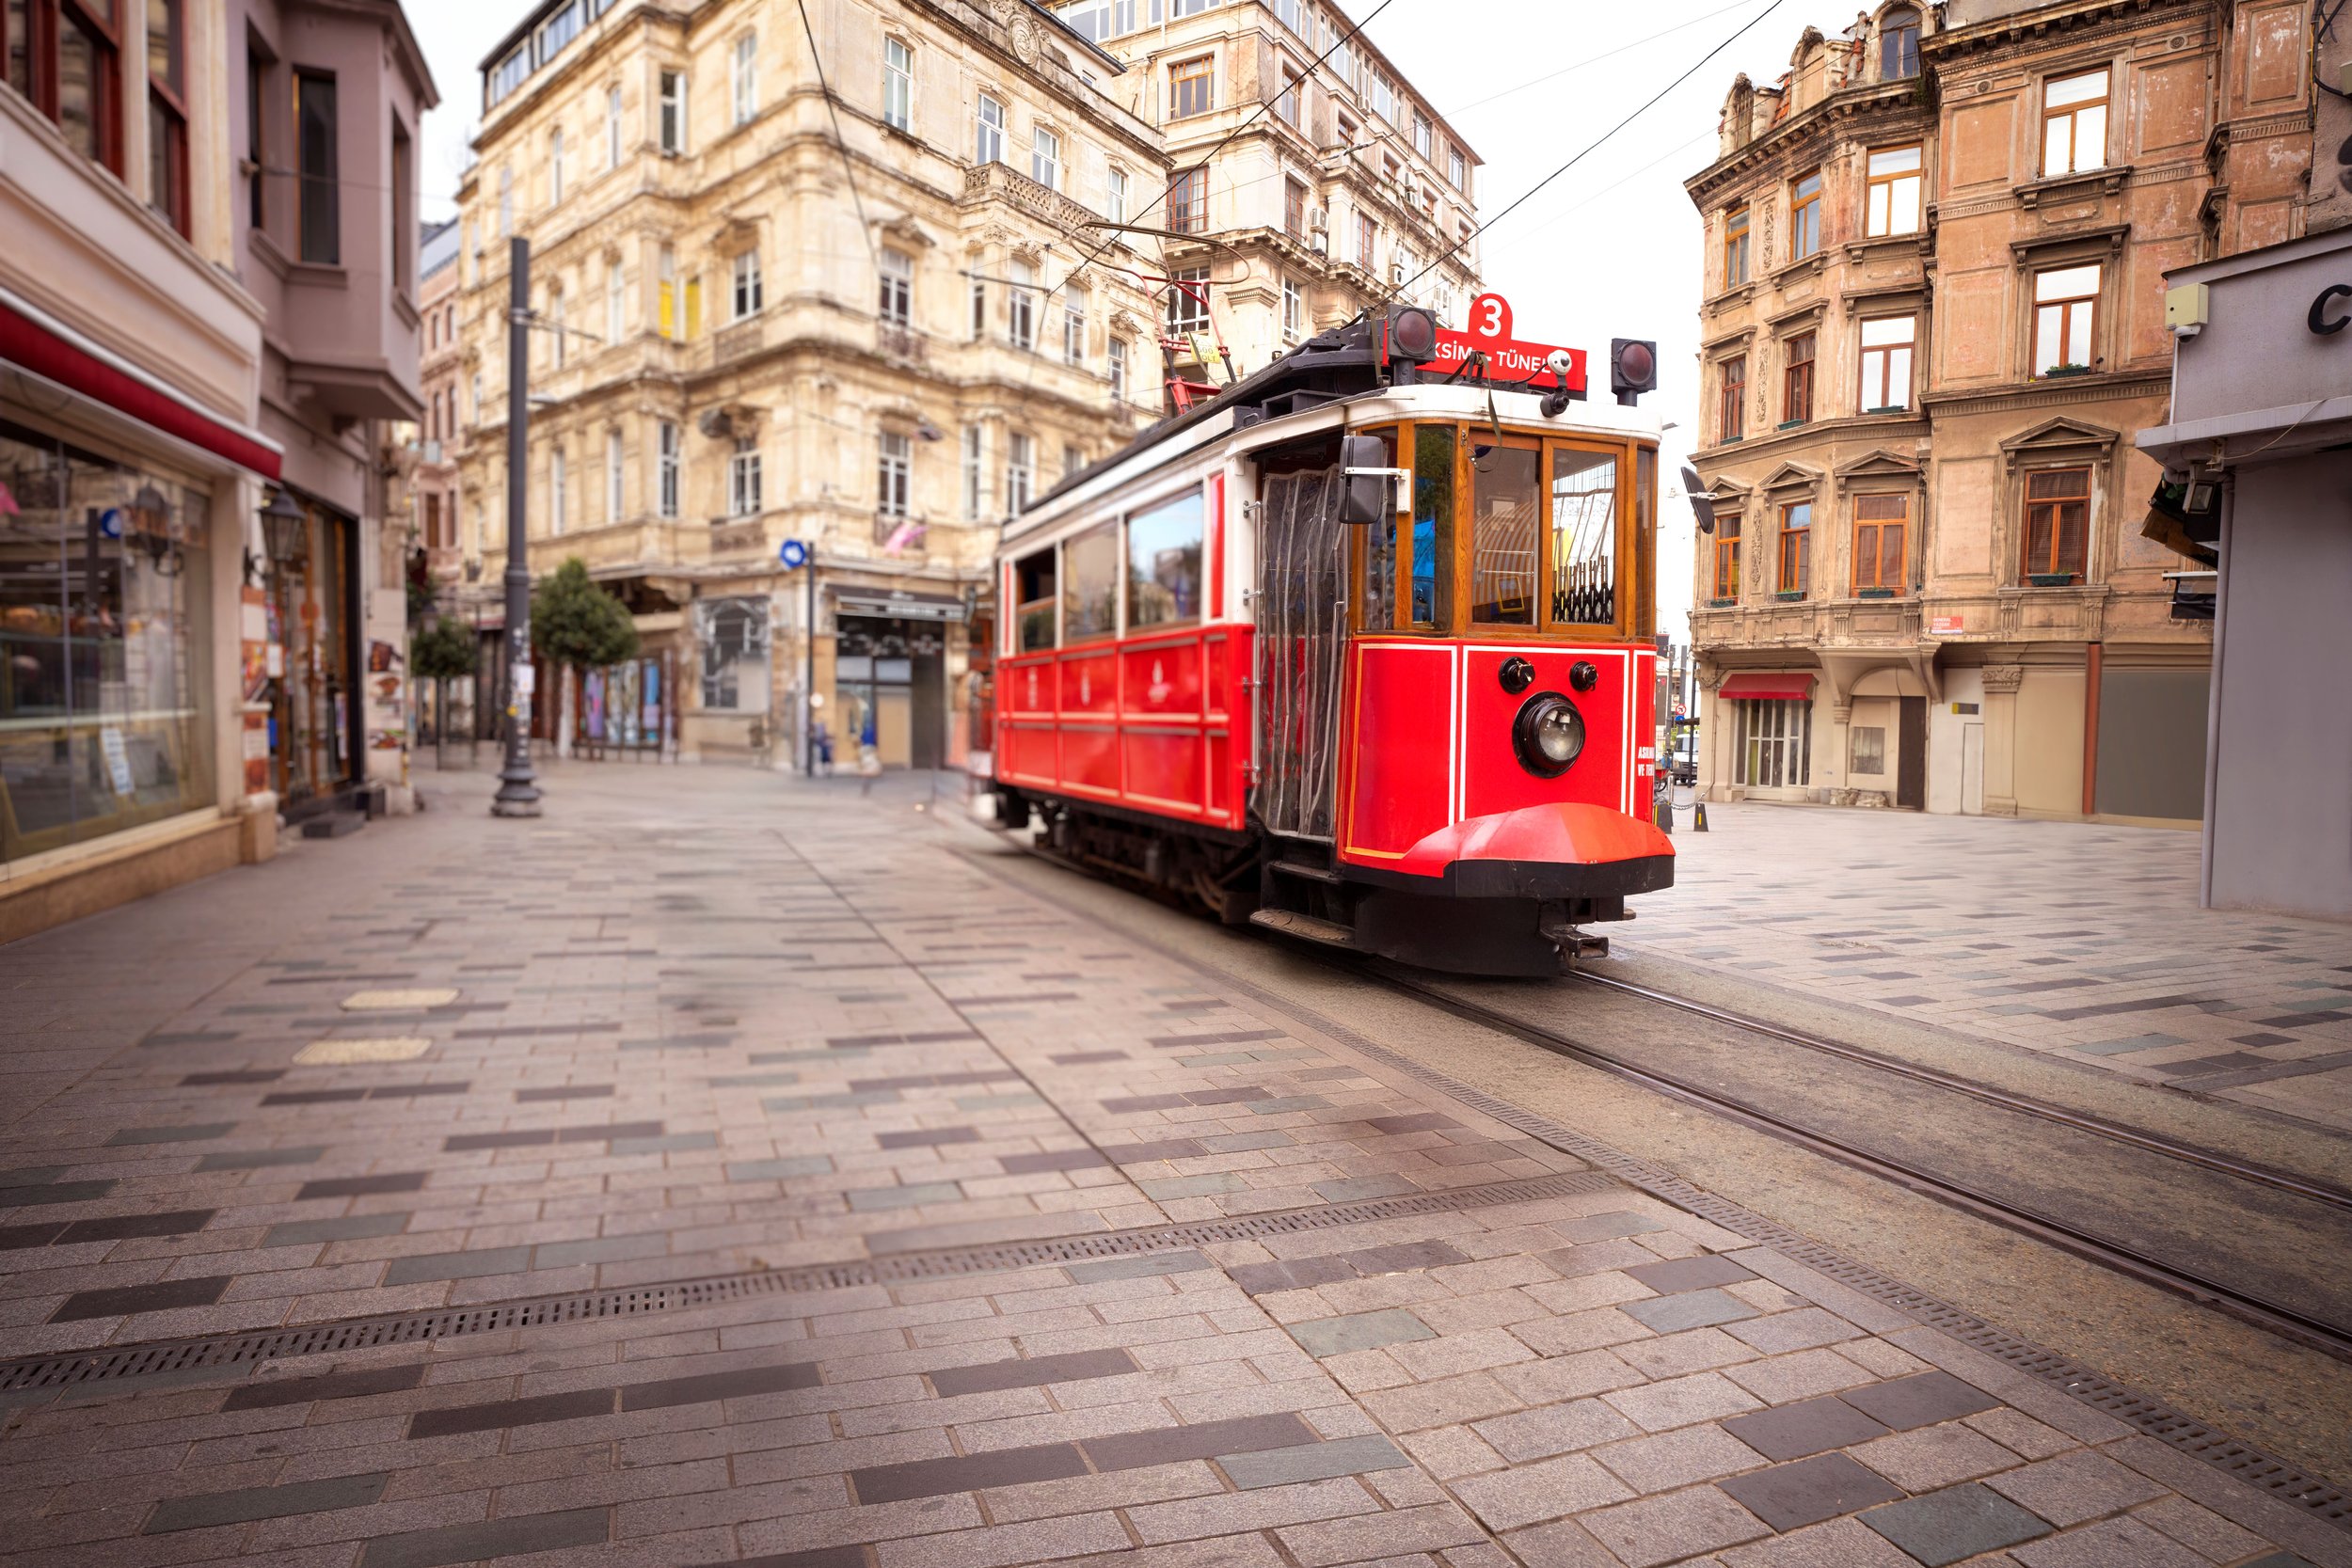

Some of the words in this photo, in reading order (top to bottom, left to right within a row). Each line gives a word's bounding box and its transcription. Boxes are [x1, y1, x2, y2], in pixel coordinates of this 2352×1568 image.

[1479, 298, 1502, 337] 3
[1200, 346, 1214, 355] 00
[1496, 349, 1551, 373] TÜNEL
[1638, 764, 1645, 777] VE
